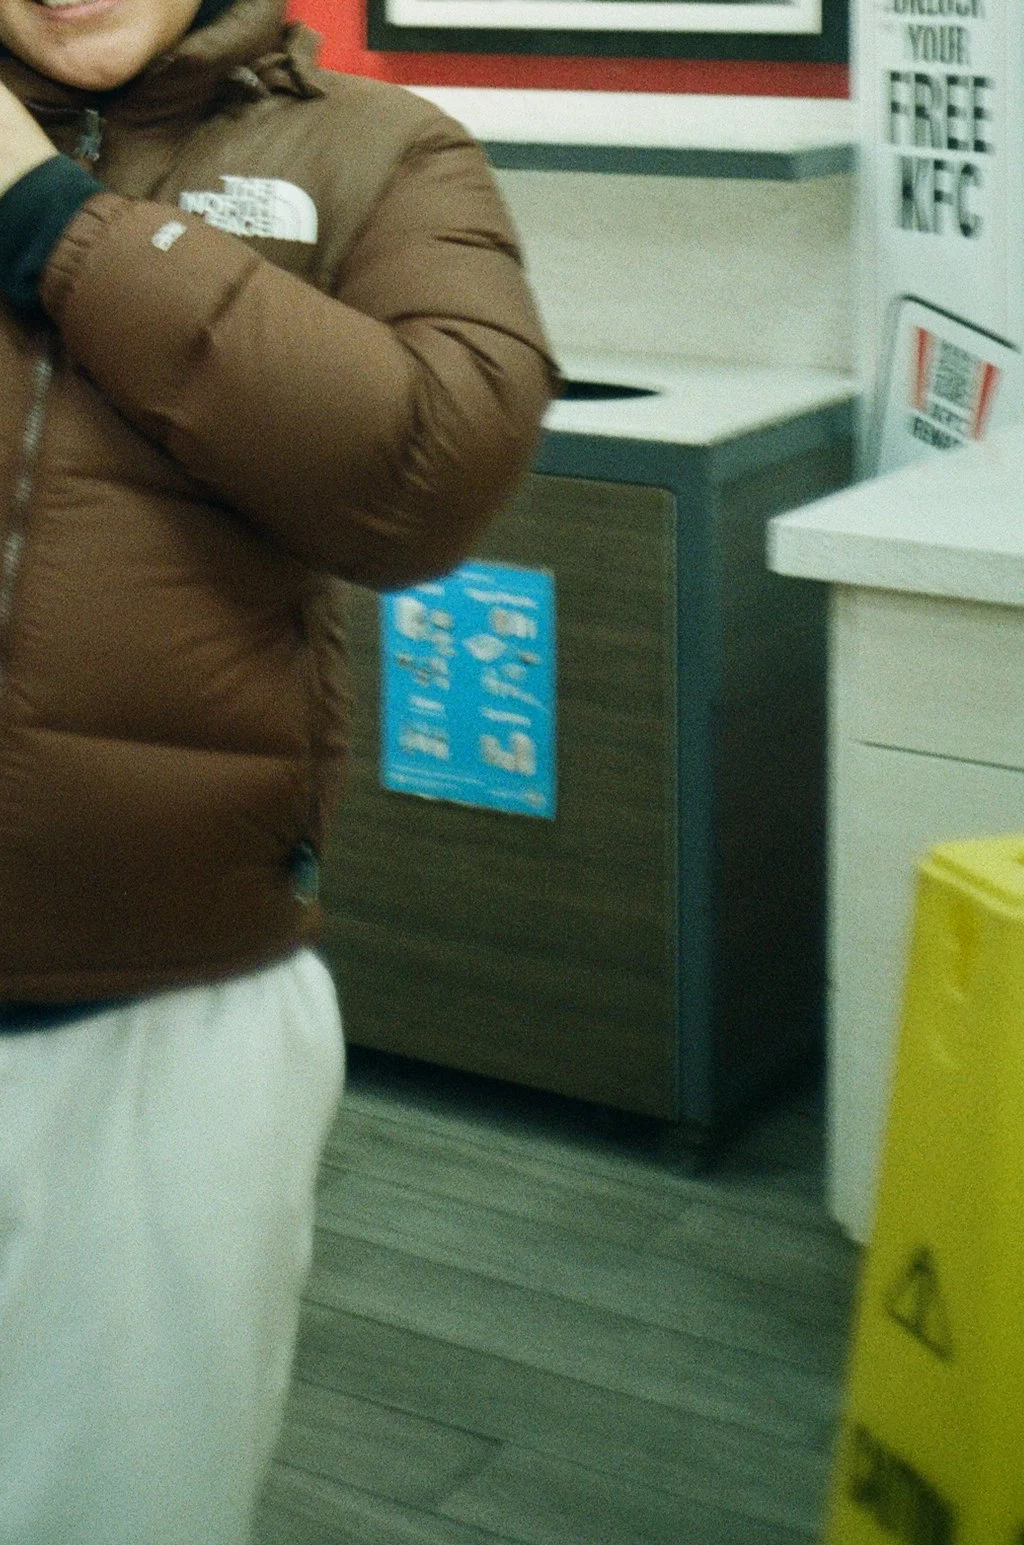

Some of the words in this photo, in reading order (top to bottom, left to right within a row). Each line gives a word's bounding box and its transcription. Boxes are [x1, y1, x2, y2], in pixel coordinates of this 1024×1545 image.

[906, 23, 968, 66] YOUR
[886, 70, 994, 154] FREE
[219, 174, 274, 202] THE
[896, 155, 984, 239] KFC
